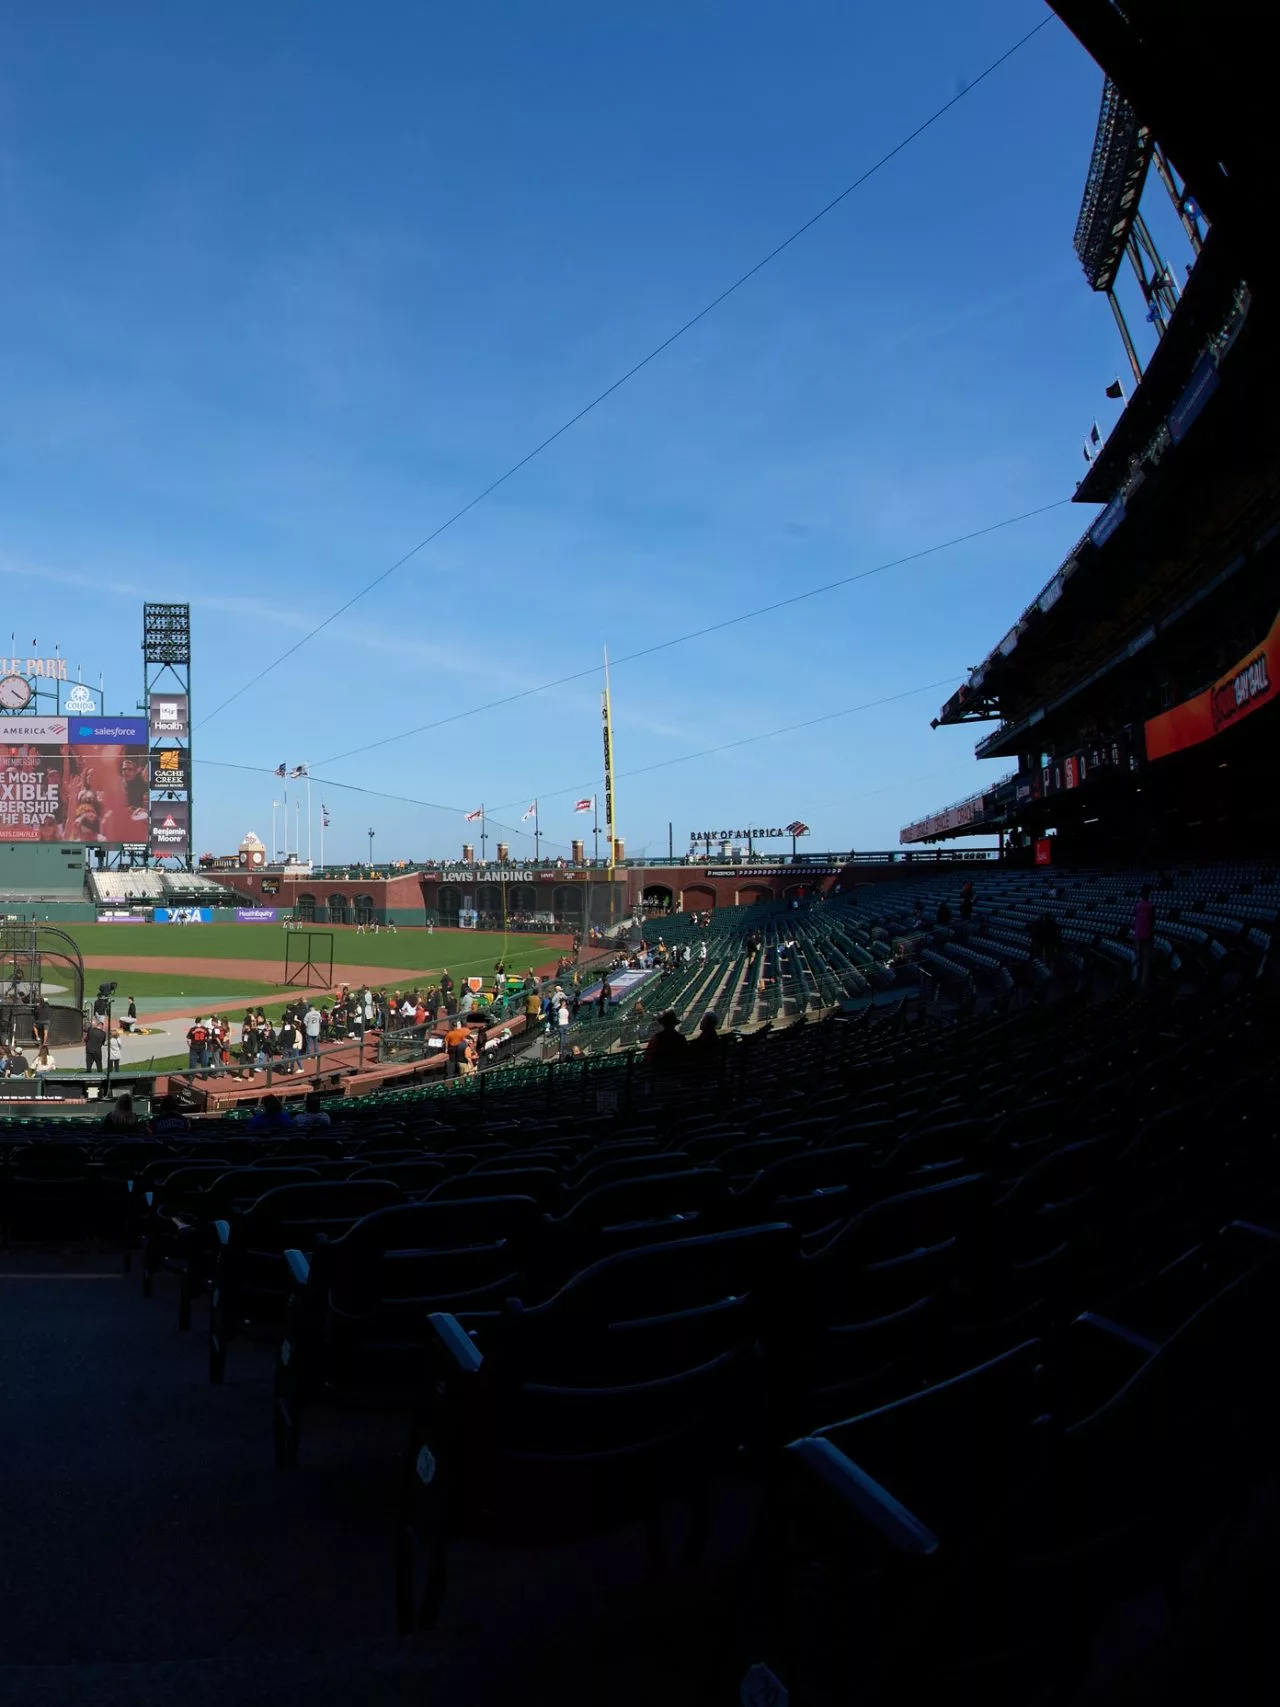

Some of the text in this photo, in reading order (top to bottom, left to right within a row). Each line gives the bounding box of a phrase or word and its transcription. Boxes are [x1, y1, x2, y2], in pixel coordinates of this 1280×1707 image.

[26, 659, 67, 680] PARK
[67, 702, 94, 711] coupa
[3, 727, 46, 735] AMERICA
[154, 722, 183, 731] Health
[94, 727, 136, 737] salesforce
[9, 772, 45, 784] MOST
[22, 813, 46, 824] BAY
[152, 828, 186, 836] Benjamin
[690, 827, 784, 840] BANK OF AMERICA
[476, 871, 532, 881] LANDING
[166, 908, 203, 922] VISA
[238, 910, 273, 919] HealthEquity
